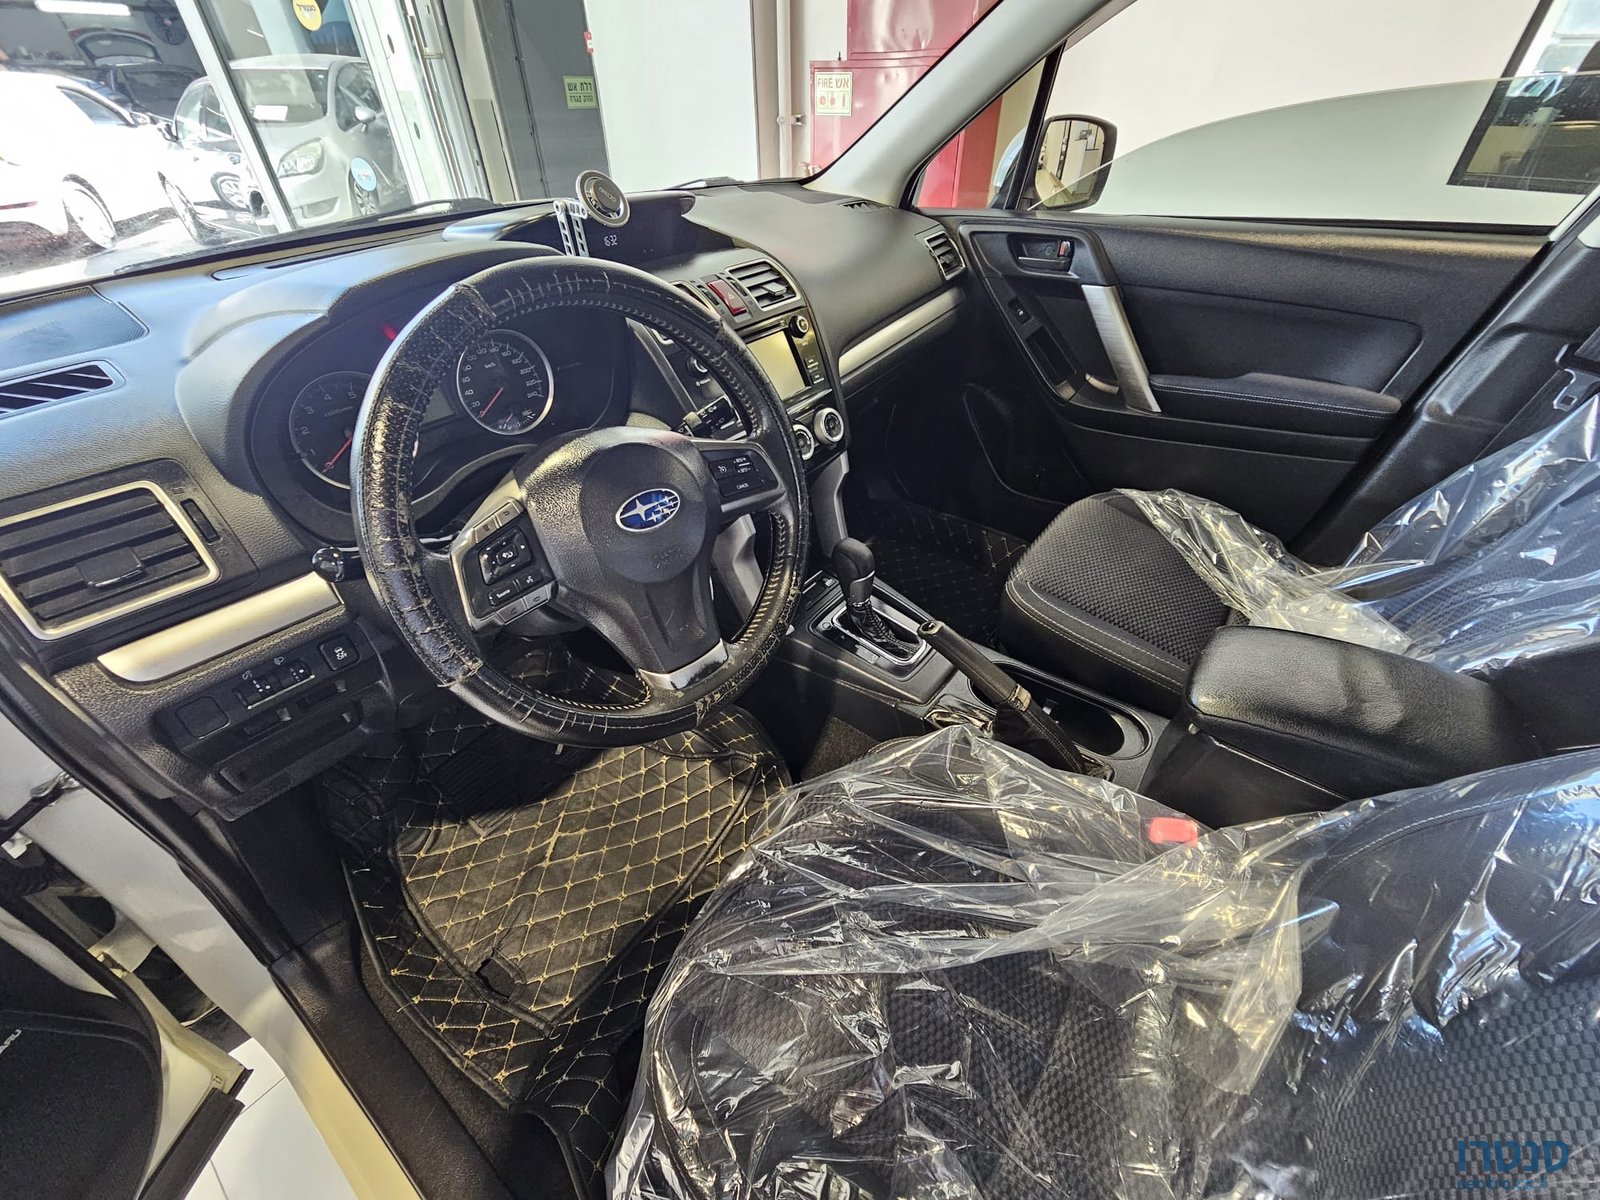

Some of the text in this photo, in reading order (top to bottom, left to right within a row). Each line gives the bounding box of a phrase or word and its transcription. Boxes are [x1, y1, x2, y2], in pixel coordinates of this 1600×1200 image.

[579, 81, 593, 92] דלת
[817, 77, 850, 89] FIRE אש
[324, 393, 332, 401] 4
[348, 391, 357, 399] 5
[304, 406, 314, 415] 3
[300, 426, 310, 436] 2
